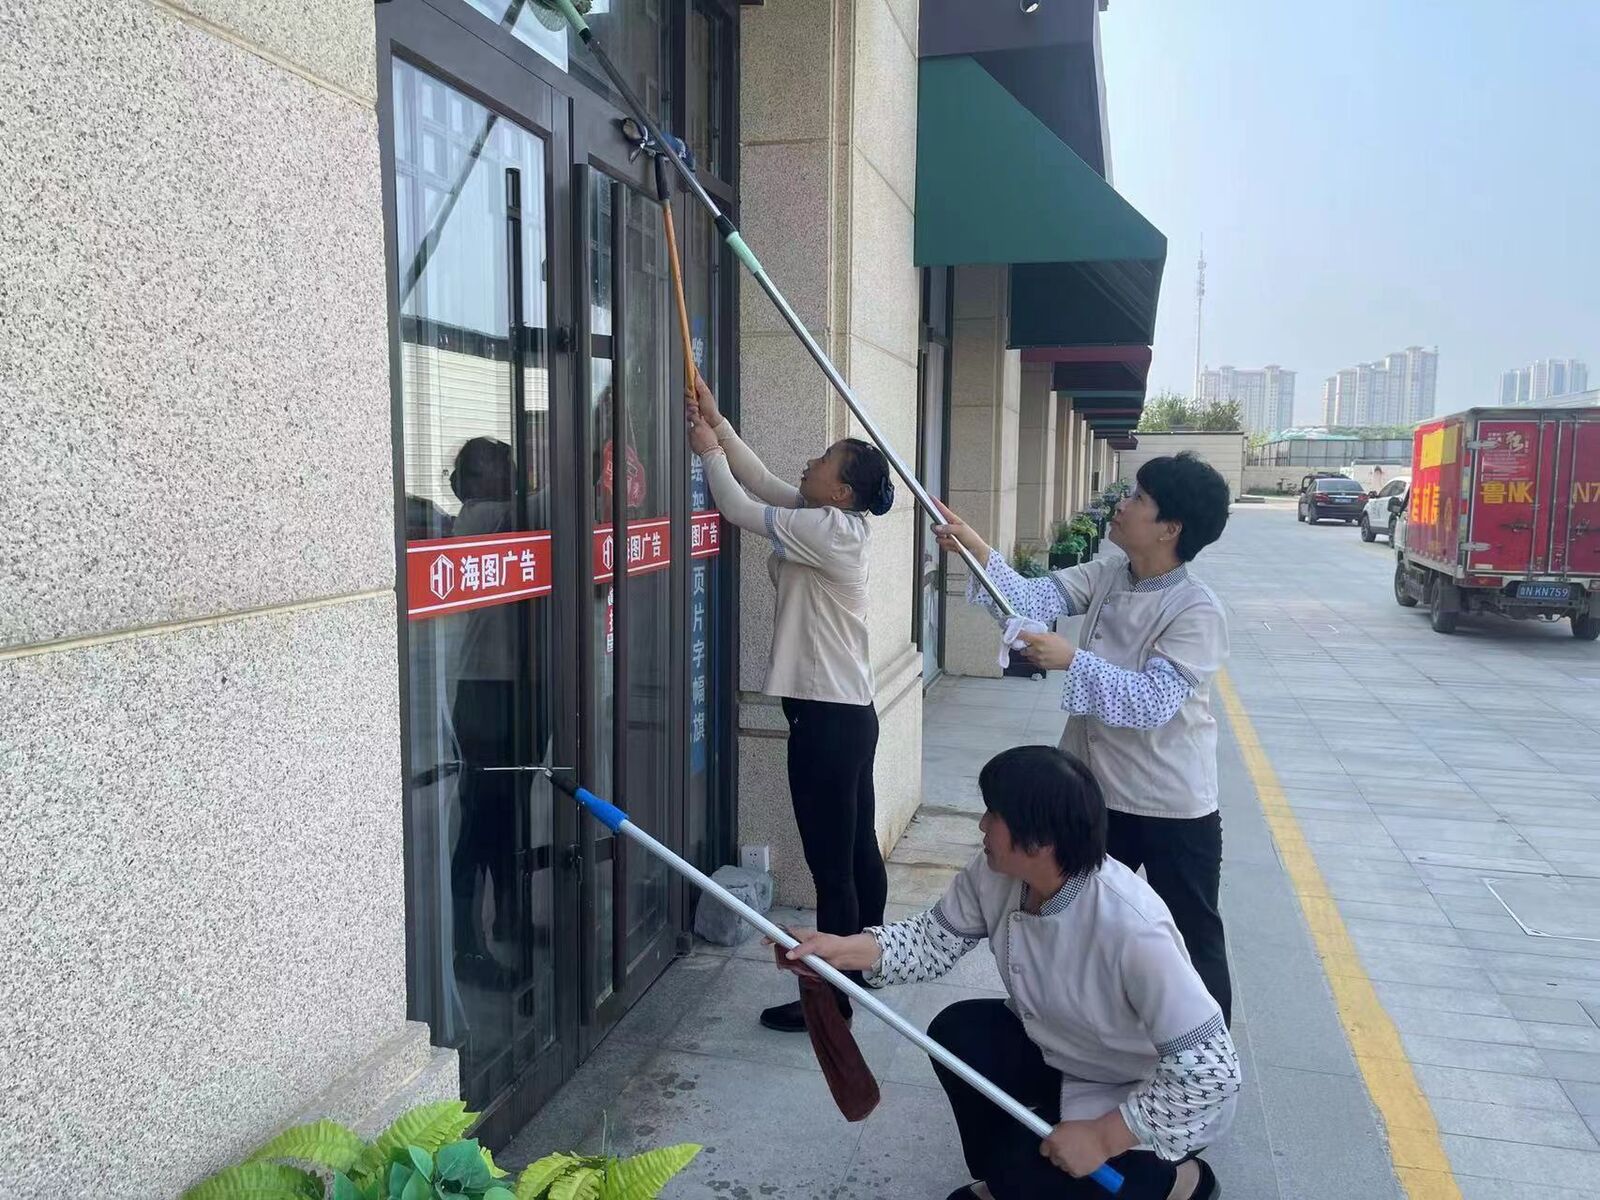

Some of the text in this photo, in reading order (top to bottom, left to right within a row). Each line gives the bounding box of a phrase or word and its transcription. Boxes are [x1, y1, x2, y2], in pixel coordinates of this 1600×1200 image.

[627, 531, 662, 563] 图广告
[459, 548, 536, 592] 海图广告
